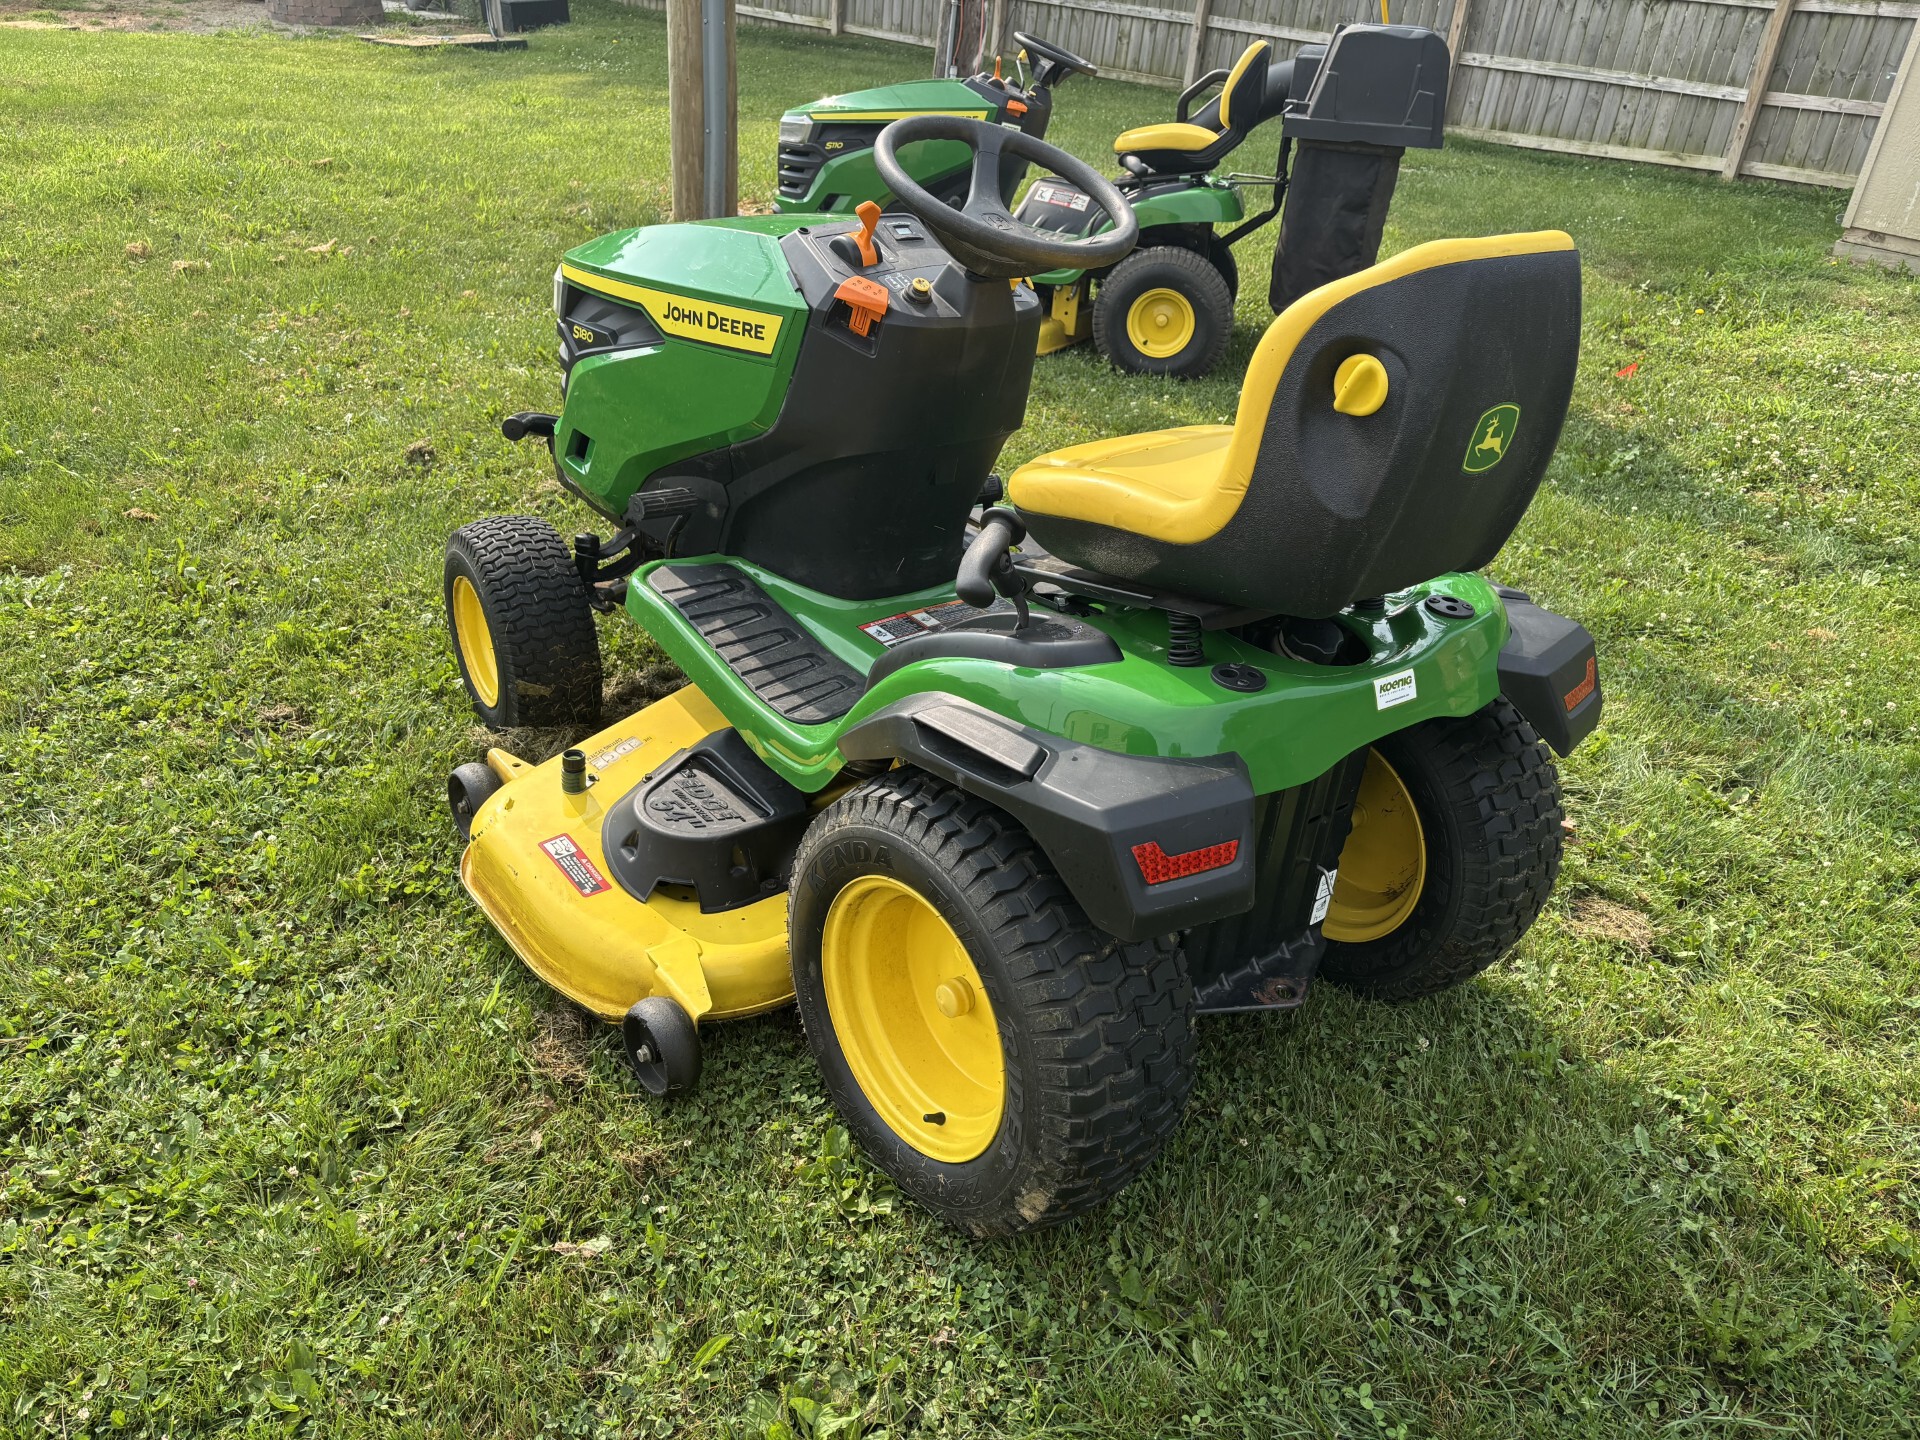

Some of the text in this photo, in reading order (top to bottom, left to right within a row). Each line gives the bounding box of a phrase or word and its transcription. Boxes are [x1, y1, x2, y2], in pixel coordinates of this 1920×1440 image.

[573, 325, 594, 342] S180
[663, 302, 765, 340] JOHN DEERE
[590, 736, 643, 770] EDGE
[674, 778, 742, 821] EDGE
[584, 862, 602, 880] DANGER
[806, 840, 894, 896] KENDA
